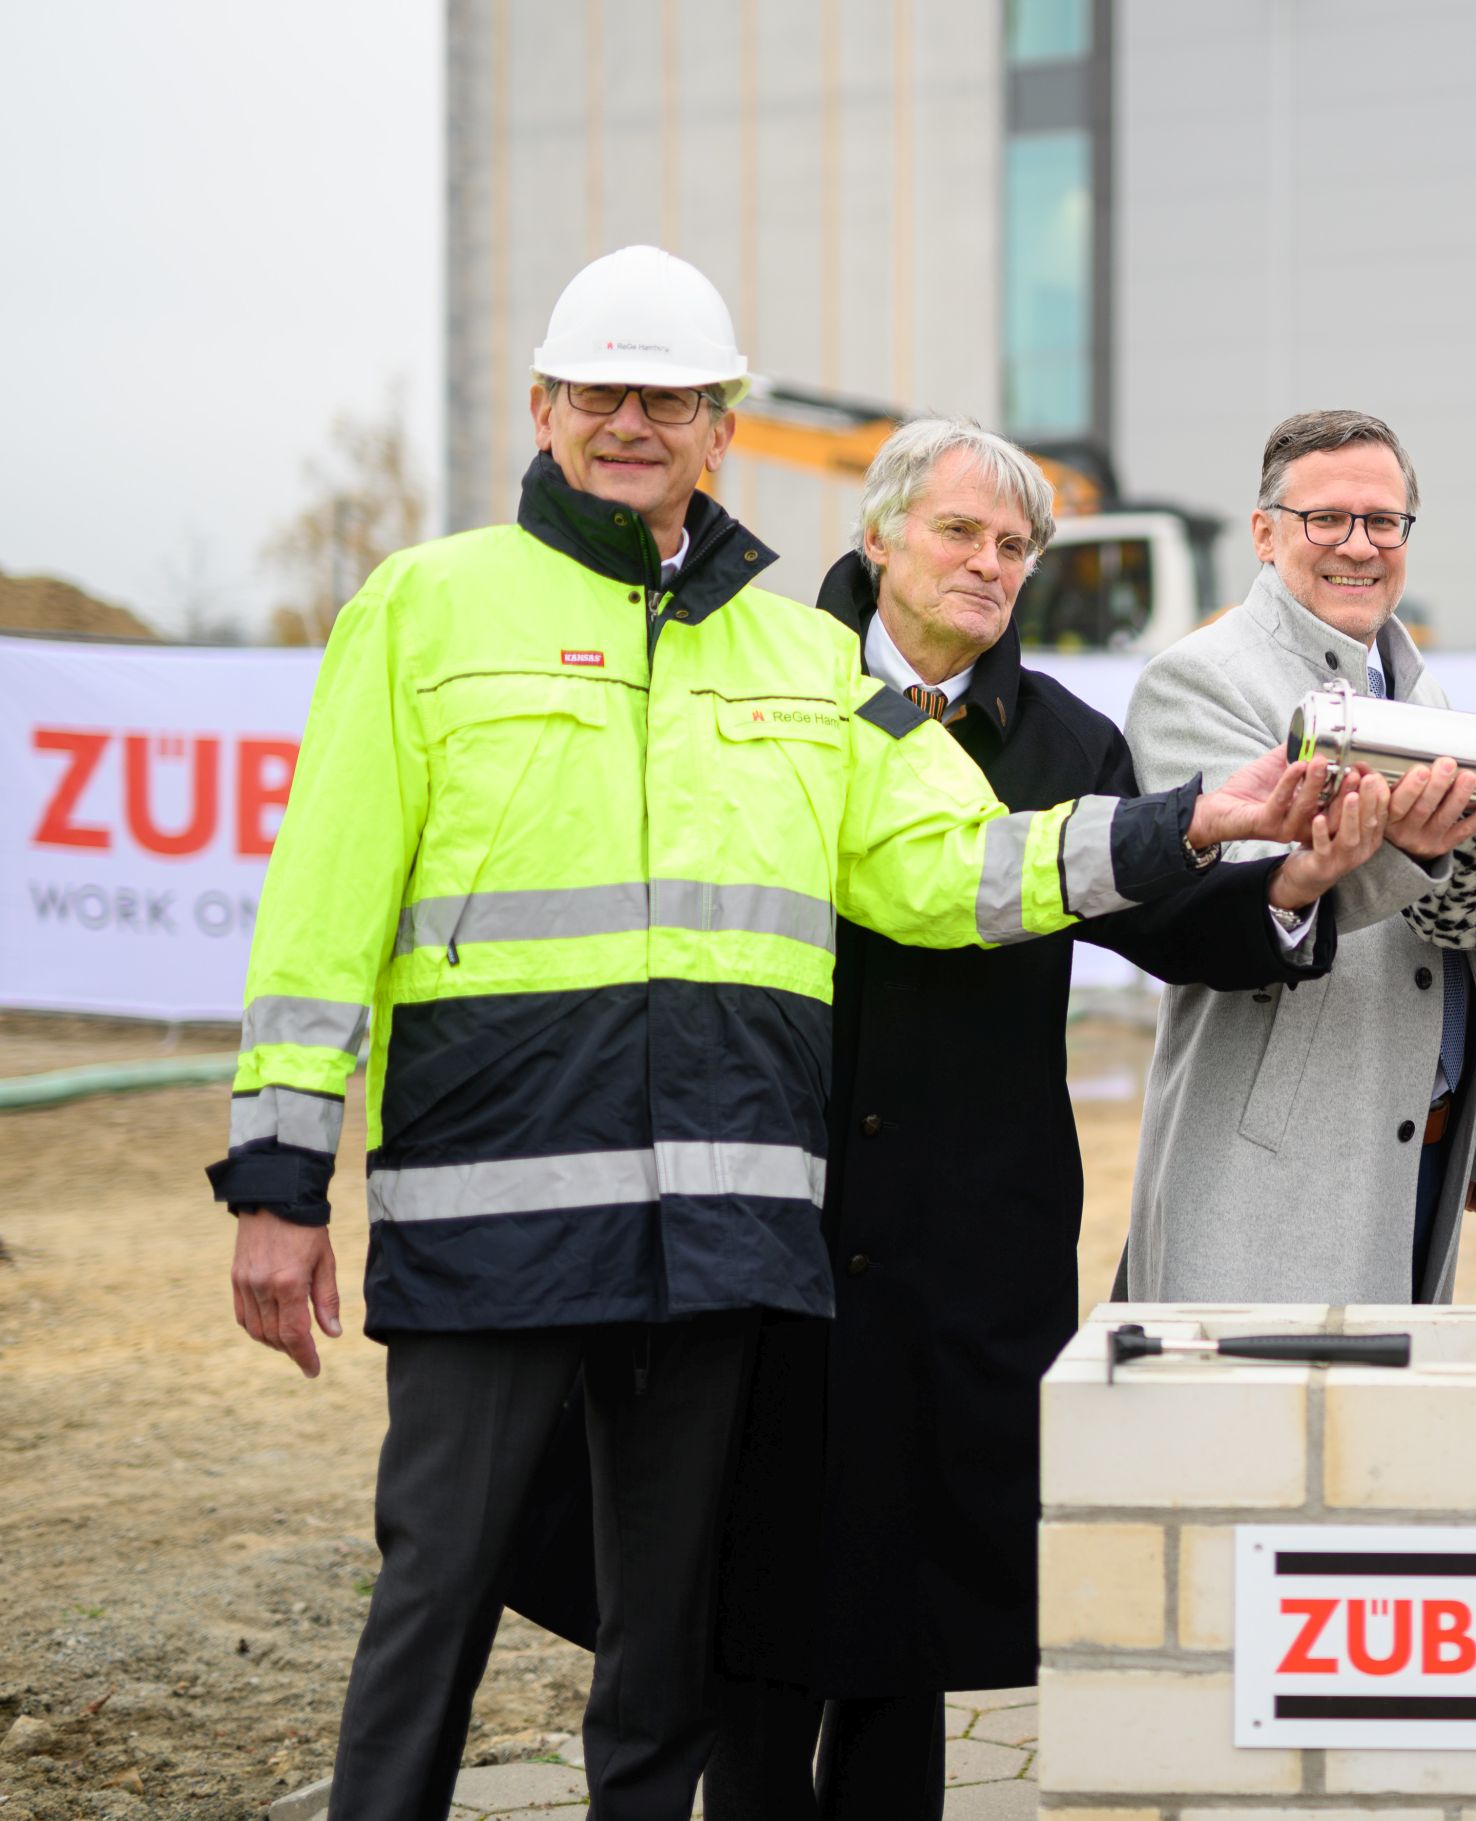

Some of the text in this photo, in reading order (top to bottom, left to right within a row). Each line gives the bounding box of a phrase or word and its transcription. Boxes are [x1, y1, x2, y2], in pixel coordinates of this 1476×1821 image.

[564, 653, 601, 662] KANSAS
[772, 711, 811, 723] ReGe
[29, 879, 177, 934] WORK
